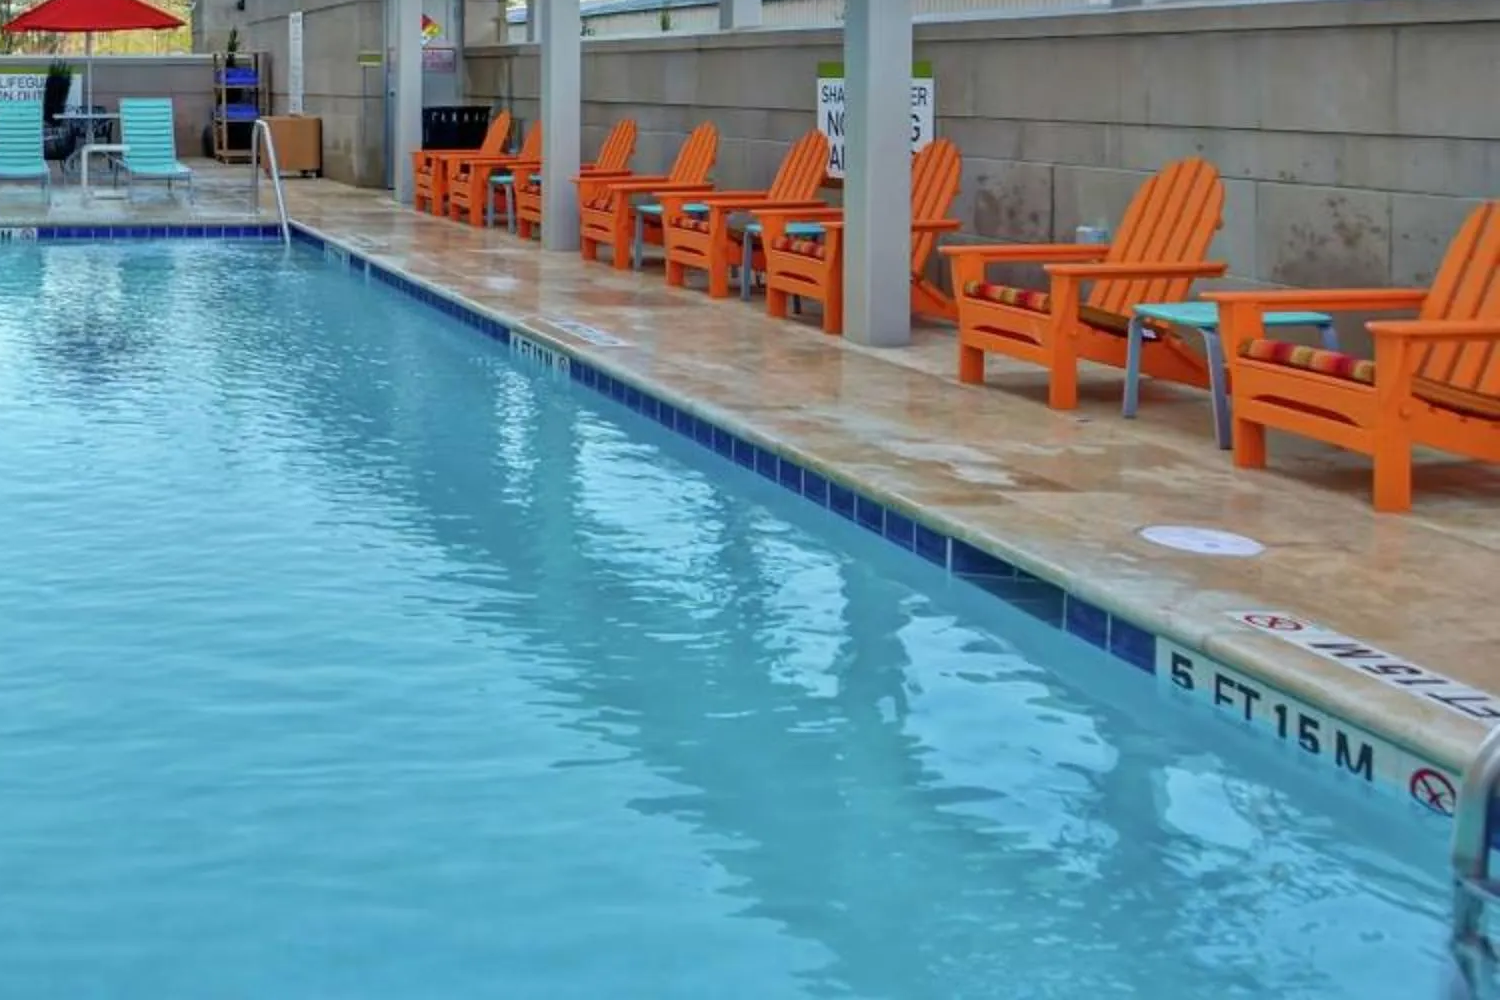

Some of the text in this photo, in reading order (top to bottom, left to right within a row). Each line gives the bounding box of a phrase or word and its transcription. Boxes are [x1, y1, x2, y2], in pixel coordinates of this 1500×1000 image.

[1307, 643, 1389, 659] M
[1171, 651, 1194, 690] 5
[1213, 672, 1261, 721] FT
[1335, 730, 1374, 782] M
